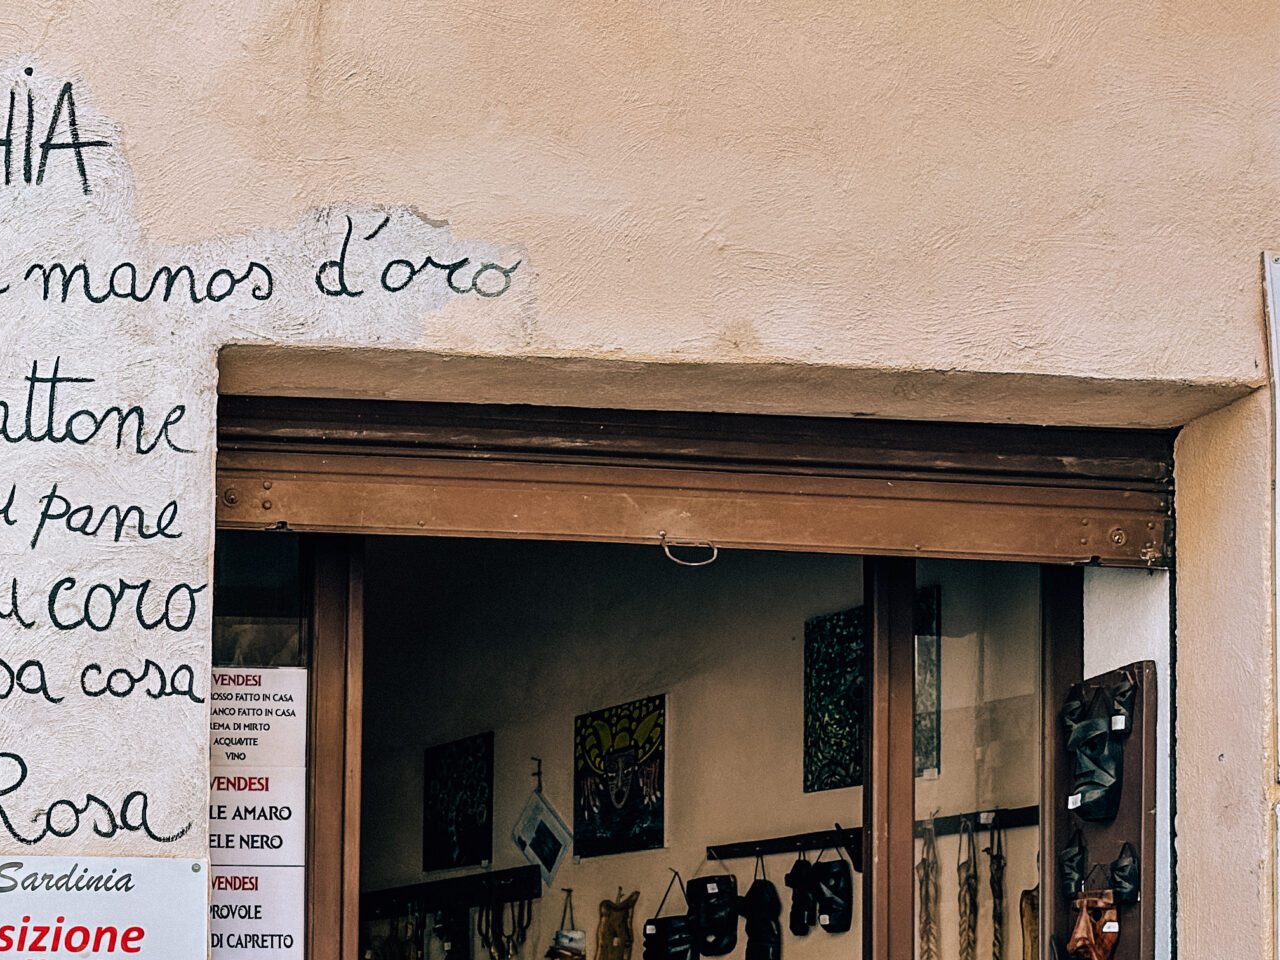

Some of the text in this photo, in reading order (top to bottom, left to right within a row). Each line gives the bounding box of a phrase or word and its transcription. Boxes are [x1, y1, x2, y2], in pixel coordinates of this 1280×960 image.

[24, 262, 274, 303] manos
[315, 215, 522, 298] d'oro
[31, 484, 183, 549] pane
[48, 576, 207, 632] coro
[80, 658, 205, 704] cosa
[212, 674, 262, 686] VENDESI
[235, 693, 260, 701] FATTO
[273, 694, 293, 702] CASA
[238, 708, 263, 716] FATTO
[275, 709, 296, 717] CASA
[233, 723, 241, 731] DI
[244, 723, 270, 731] MIRTO
[213, 737, 258, 746] ACQUAVITE
[225, 752, 246, 760] VINO
[210, 776, 269, 791] VENDESI
[232, 806, 292, 820] AMARO
[239, 834, 283, 849] NERO
[211, 876, 258, 891] VENDESI
[226, 933, 294, 948] CAPRETTO
